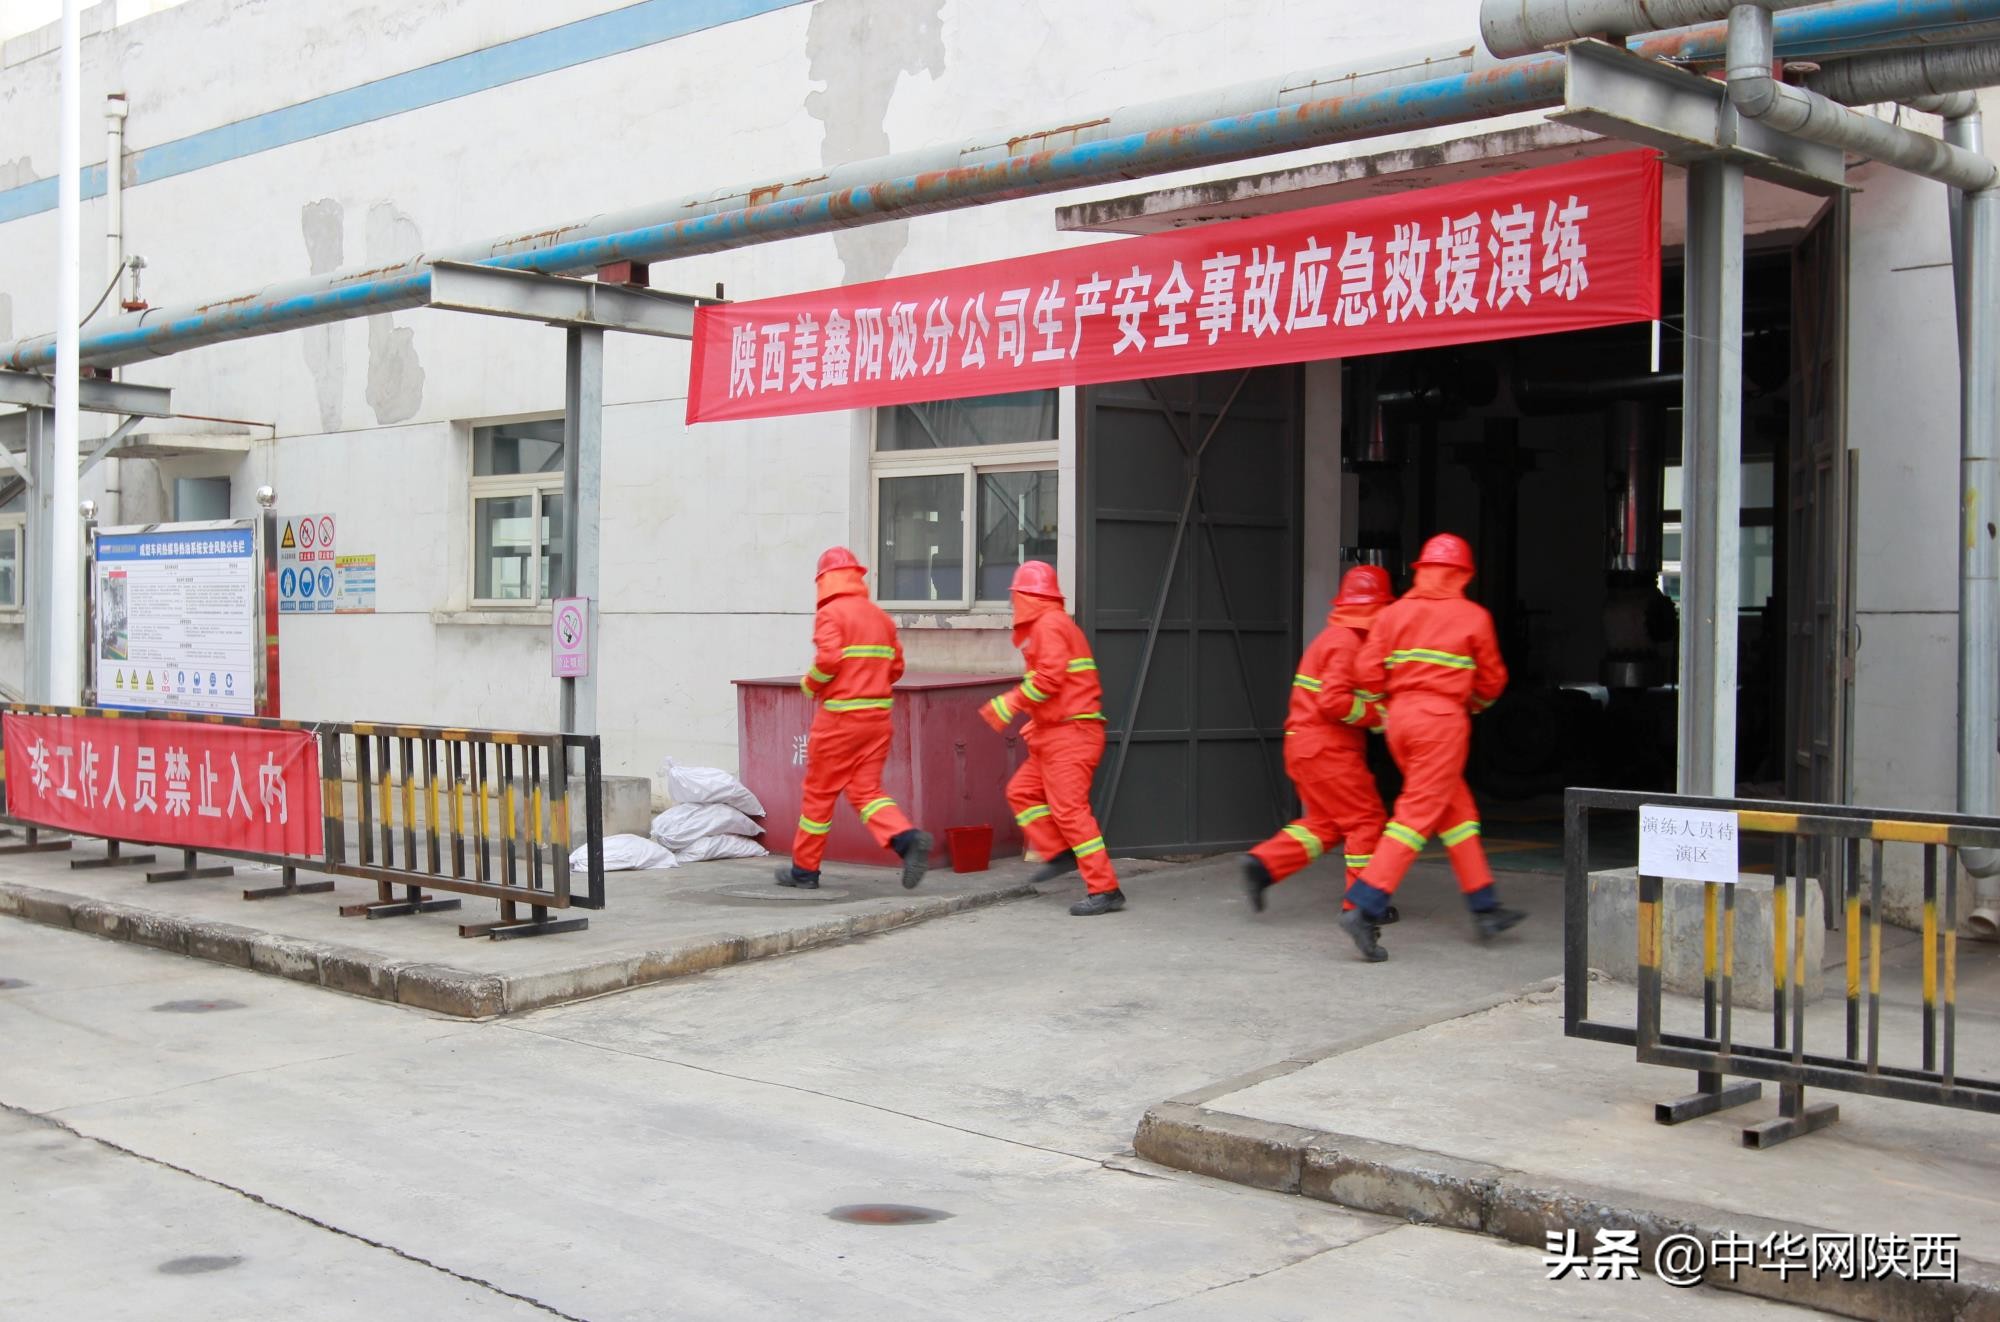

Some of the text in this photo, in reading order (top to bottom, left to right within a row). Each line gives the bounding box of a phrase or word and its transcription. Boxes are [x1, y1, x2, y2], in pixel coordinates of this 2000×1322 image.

[728, 194, 1590, 399] 陕西美鑫阳极分公司生产安全事故应急救援演练
[1642, 816, 1735, 841] 演练人员待
[1676, 845, 1710, 864] 演区
